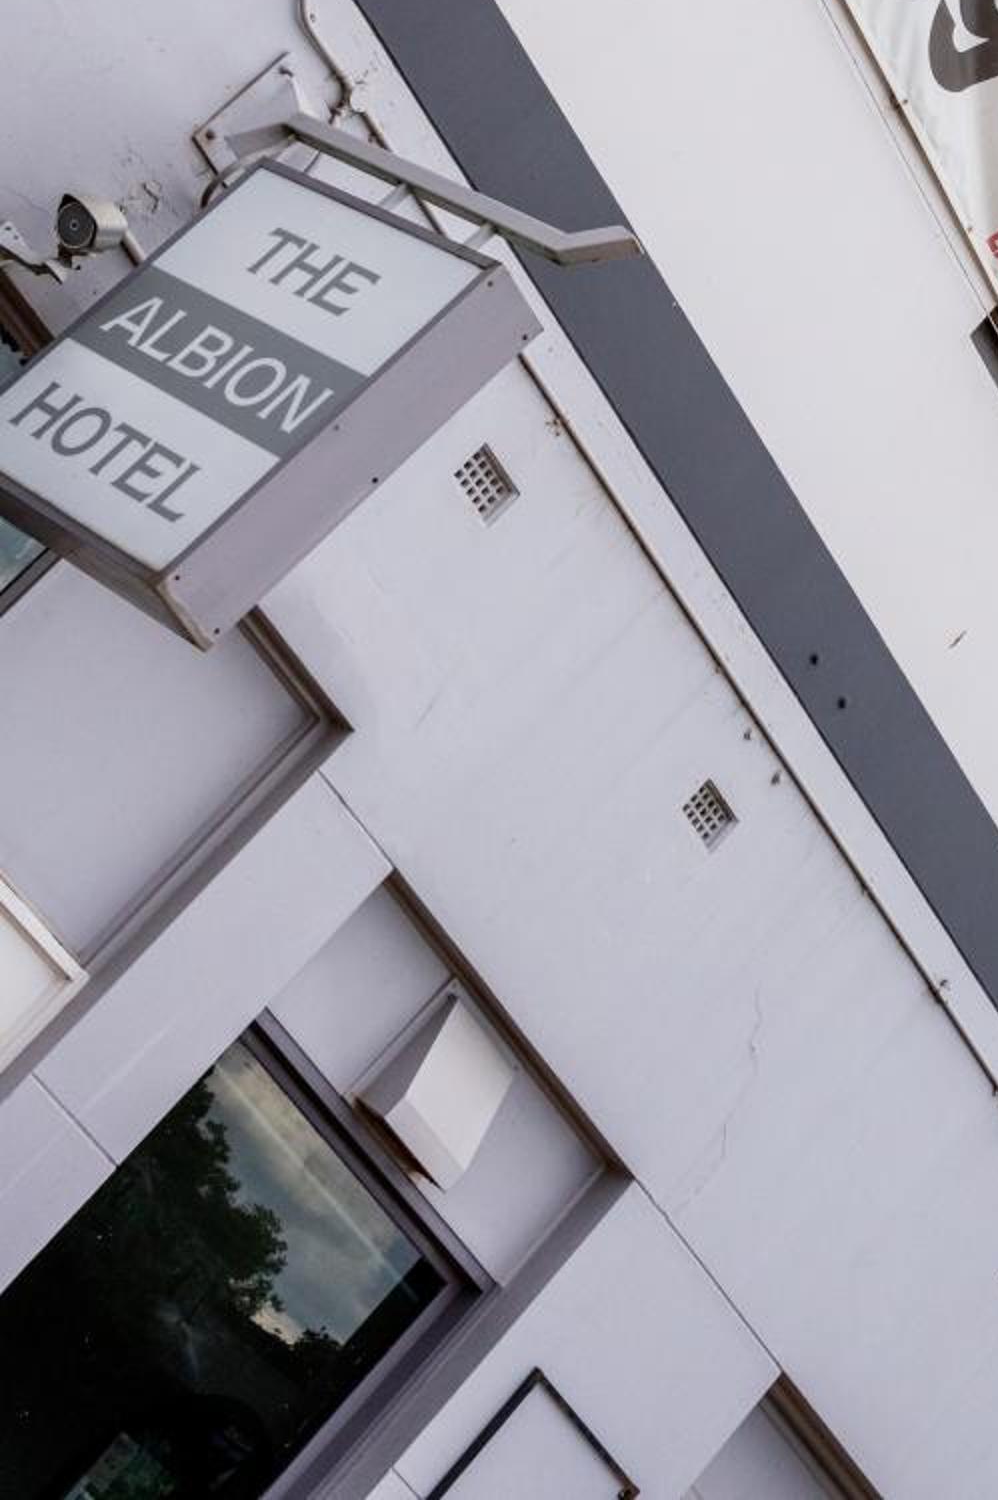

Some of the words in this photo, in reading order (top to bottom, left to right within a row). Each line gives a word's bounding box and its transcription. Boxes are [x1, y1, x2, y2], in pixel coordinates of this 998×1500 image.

[246, 226, 382, 317] THE
[99, 295, 335, 434] ALBION
[8, 380, 202, 523] HOTEL
